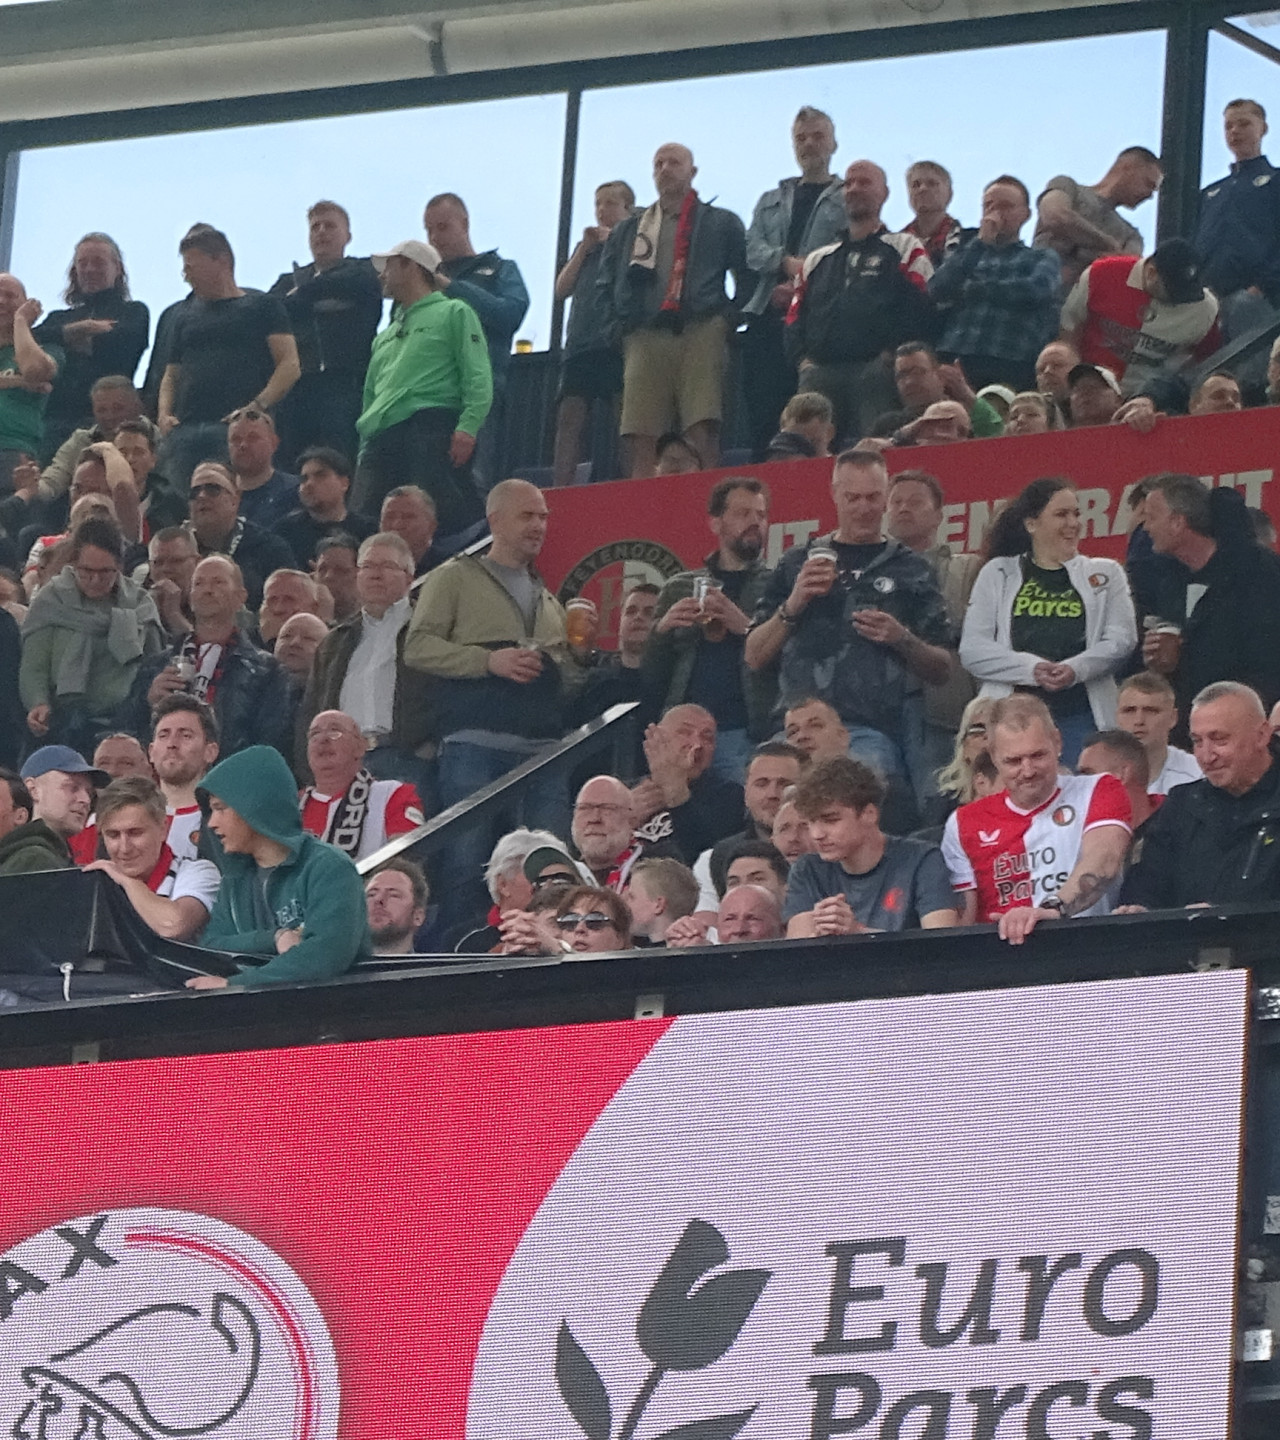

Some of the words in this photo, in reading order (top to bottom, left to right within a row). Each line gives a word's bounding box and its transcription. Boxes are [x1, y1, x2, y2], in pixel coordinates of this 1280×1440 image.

[1014, 596, 1083, 618] Parcs
[992, 846, 1056, 881] Euro
[996, 871, 1070, 907] Parcs
[811, 1236, 1161, 1359] Euro
